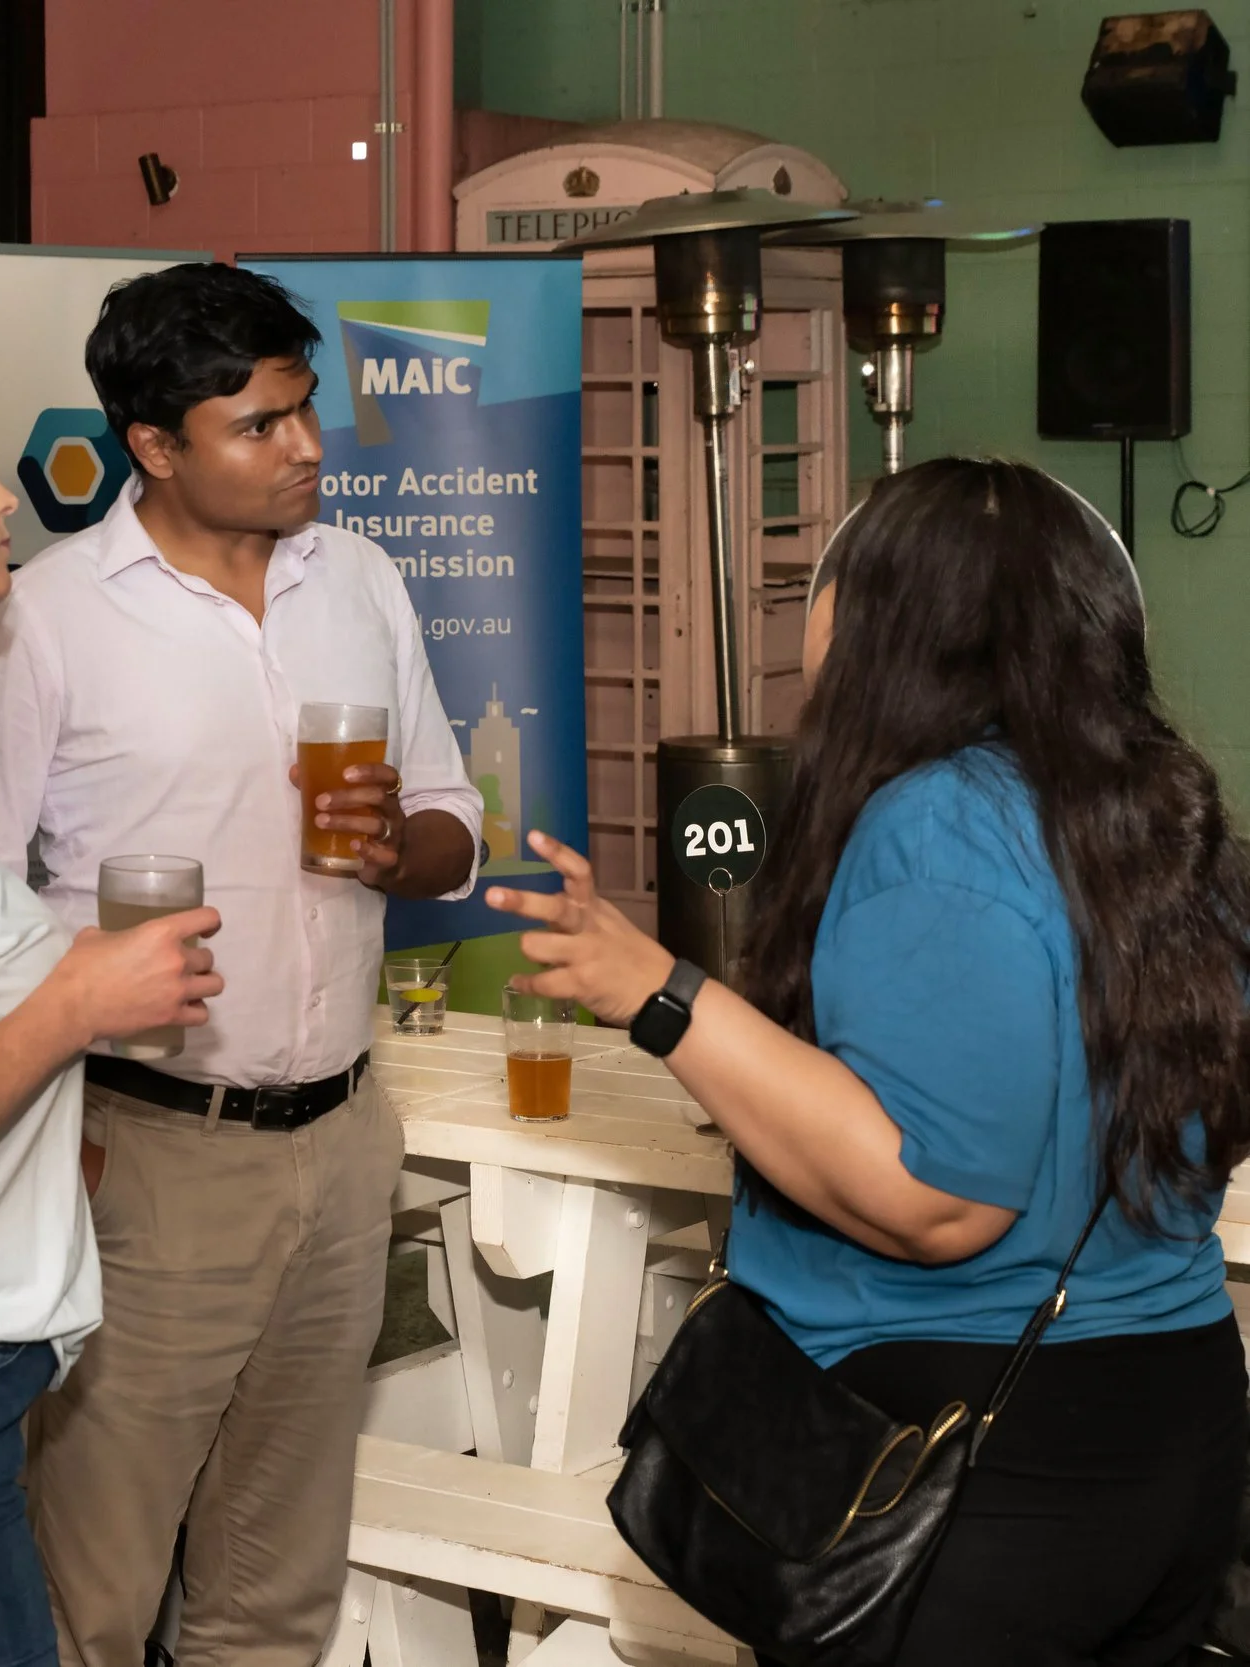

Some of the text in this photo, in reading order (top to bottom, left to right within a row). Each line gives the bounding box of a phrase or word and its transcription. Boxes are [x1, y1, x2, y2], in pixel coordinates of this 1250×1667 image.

[495, 210, 634, 242] TELEPH
[320, 466, 539, 497] otor Accident
[336, 508, 495, 538] Insurance
[390, 548, 515, 578] mission
[684, 818, 755, 857] 201
